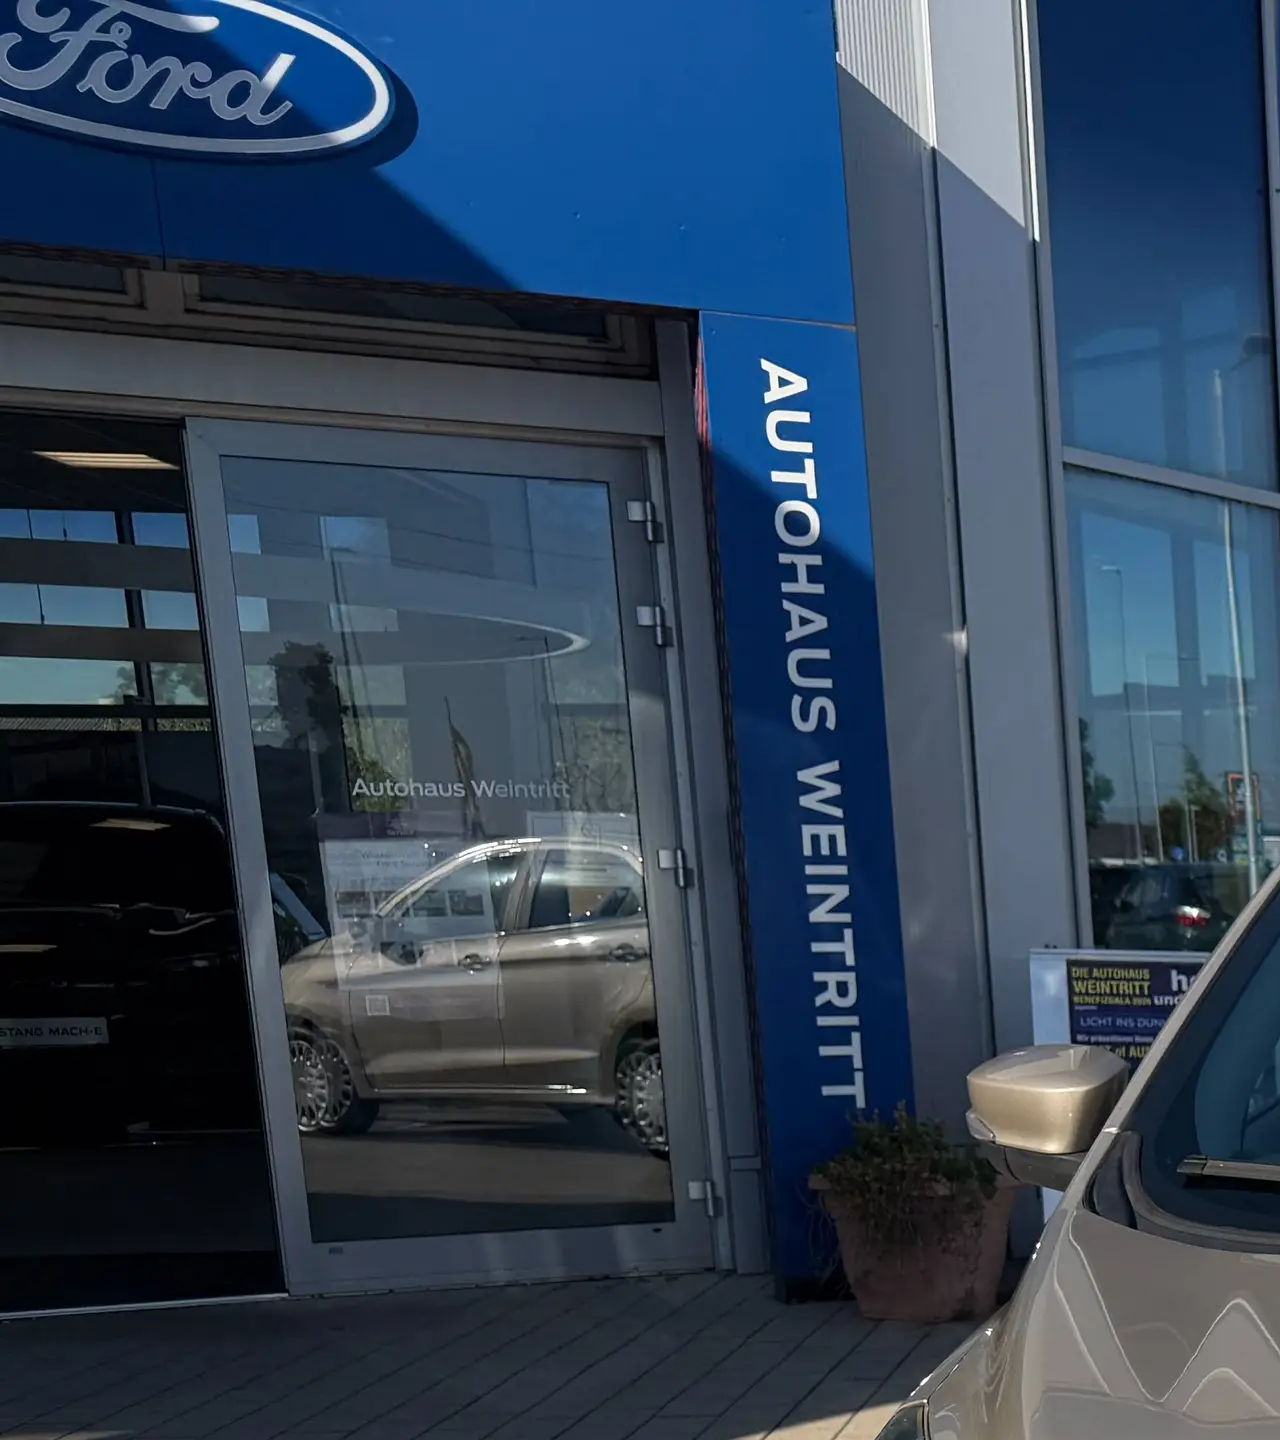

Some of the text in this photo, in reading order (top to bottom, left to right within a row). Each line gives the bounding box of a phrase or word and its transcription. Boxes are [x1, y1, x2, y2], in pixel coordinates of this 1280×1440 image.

[0, 0, 296, 126] Ford
[760, 358, 867, 1109] AUTOHAUS WEINTRITT
[351, 777, 571, 799] Autohaus Weintritt
[1071, 967, 1151, 980] DIE AUTOHAUS
[1073, 980, 1151, 995] WEINTRITT
[1080, 1016, 1113, 1028] LICHT
[1116, 1018, 1135, 1028] INS
